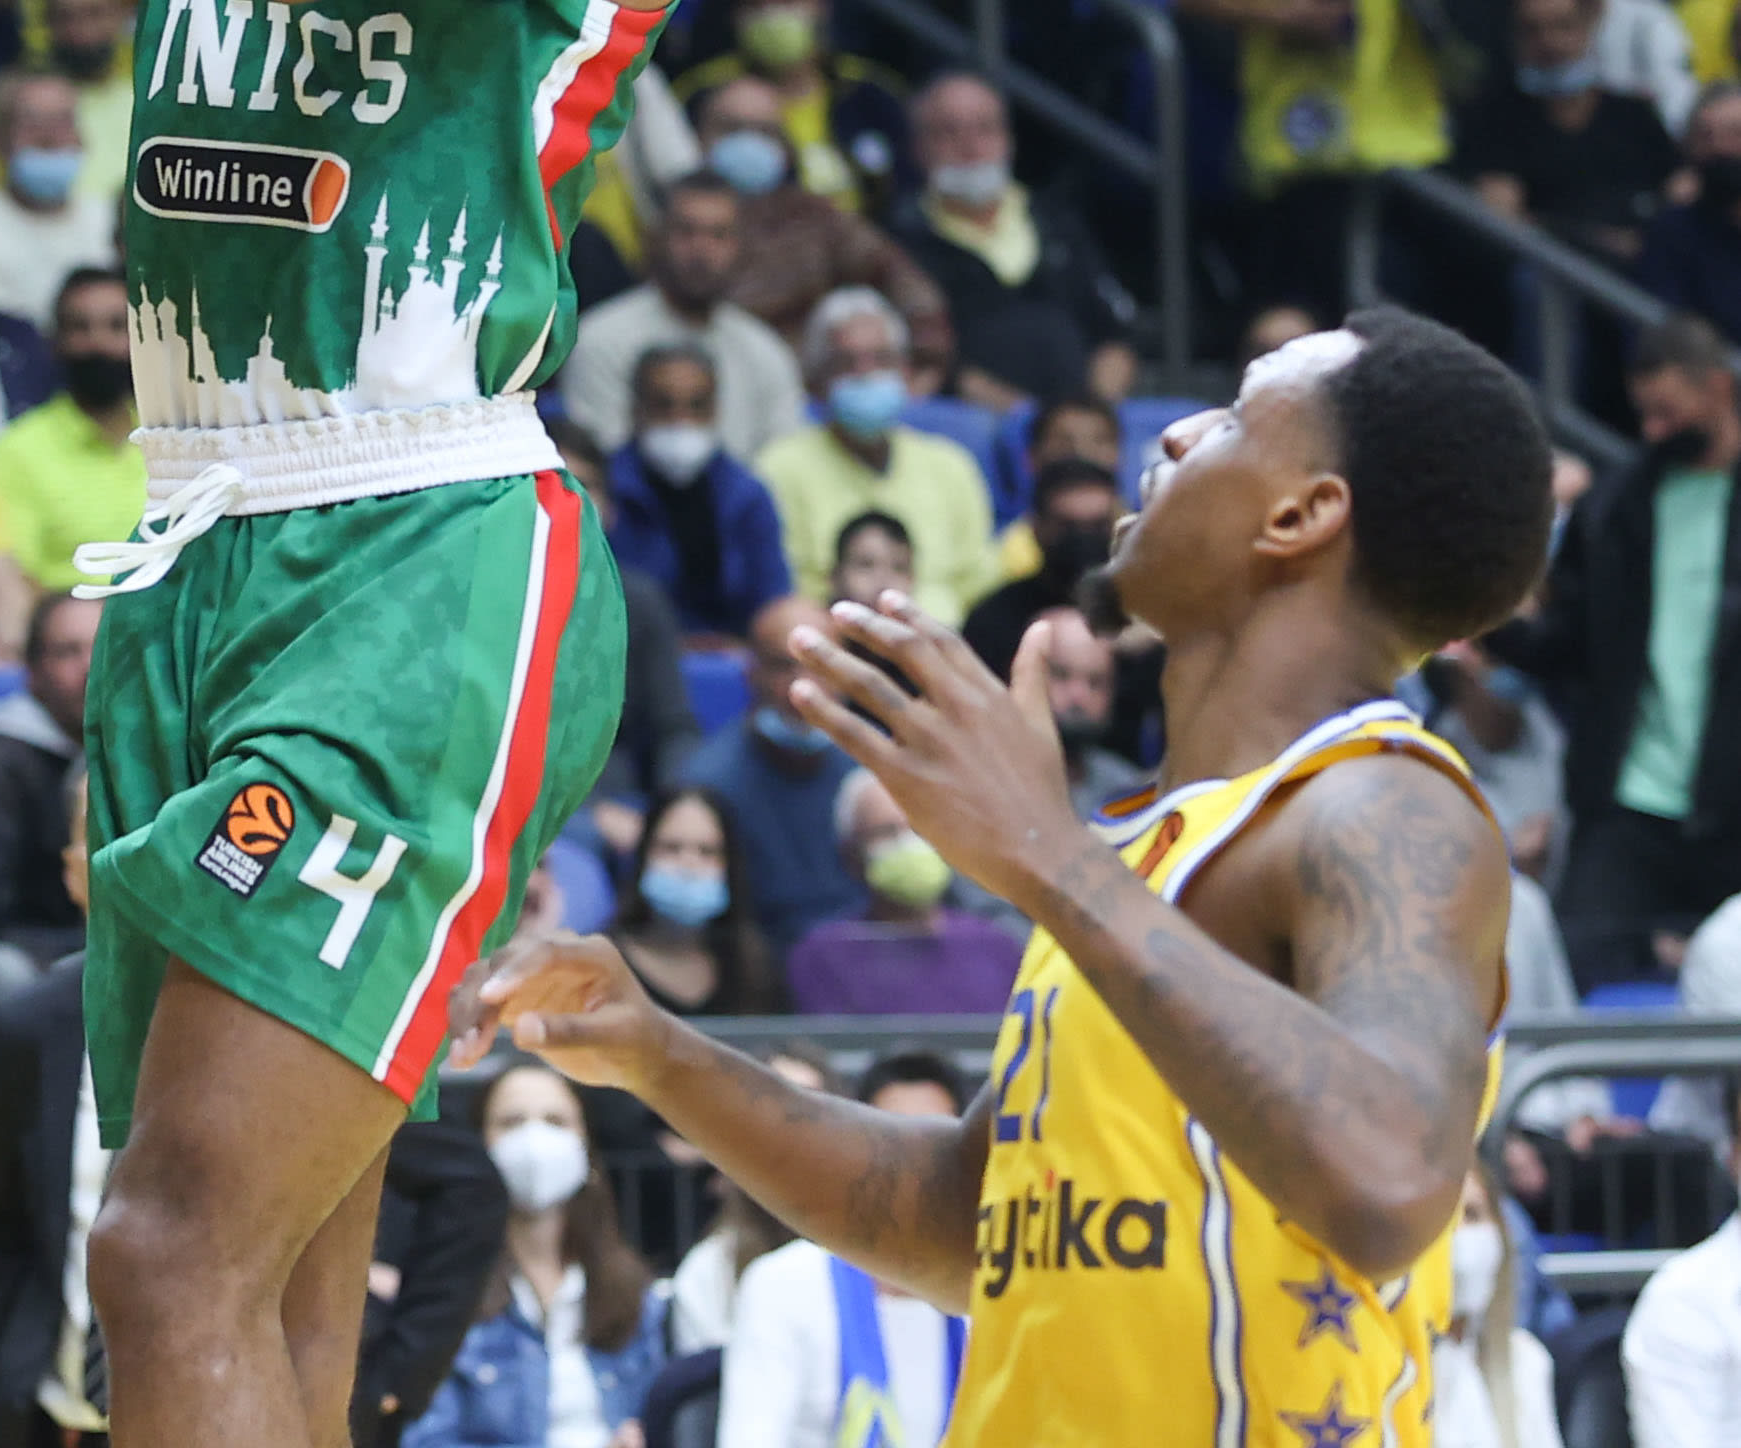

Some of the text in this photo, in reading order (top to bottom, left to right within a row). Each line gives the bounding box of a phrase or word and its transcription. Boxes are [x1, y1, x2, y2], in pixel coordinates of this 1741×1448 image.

[154, 156, 292, 207] Winline
[297, 813, 409, 970] 4
[995, 987, 1059, 1142] 21
